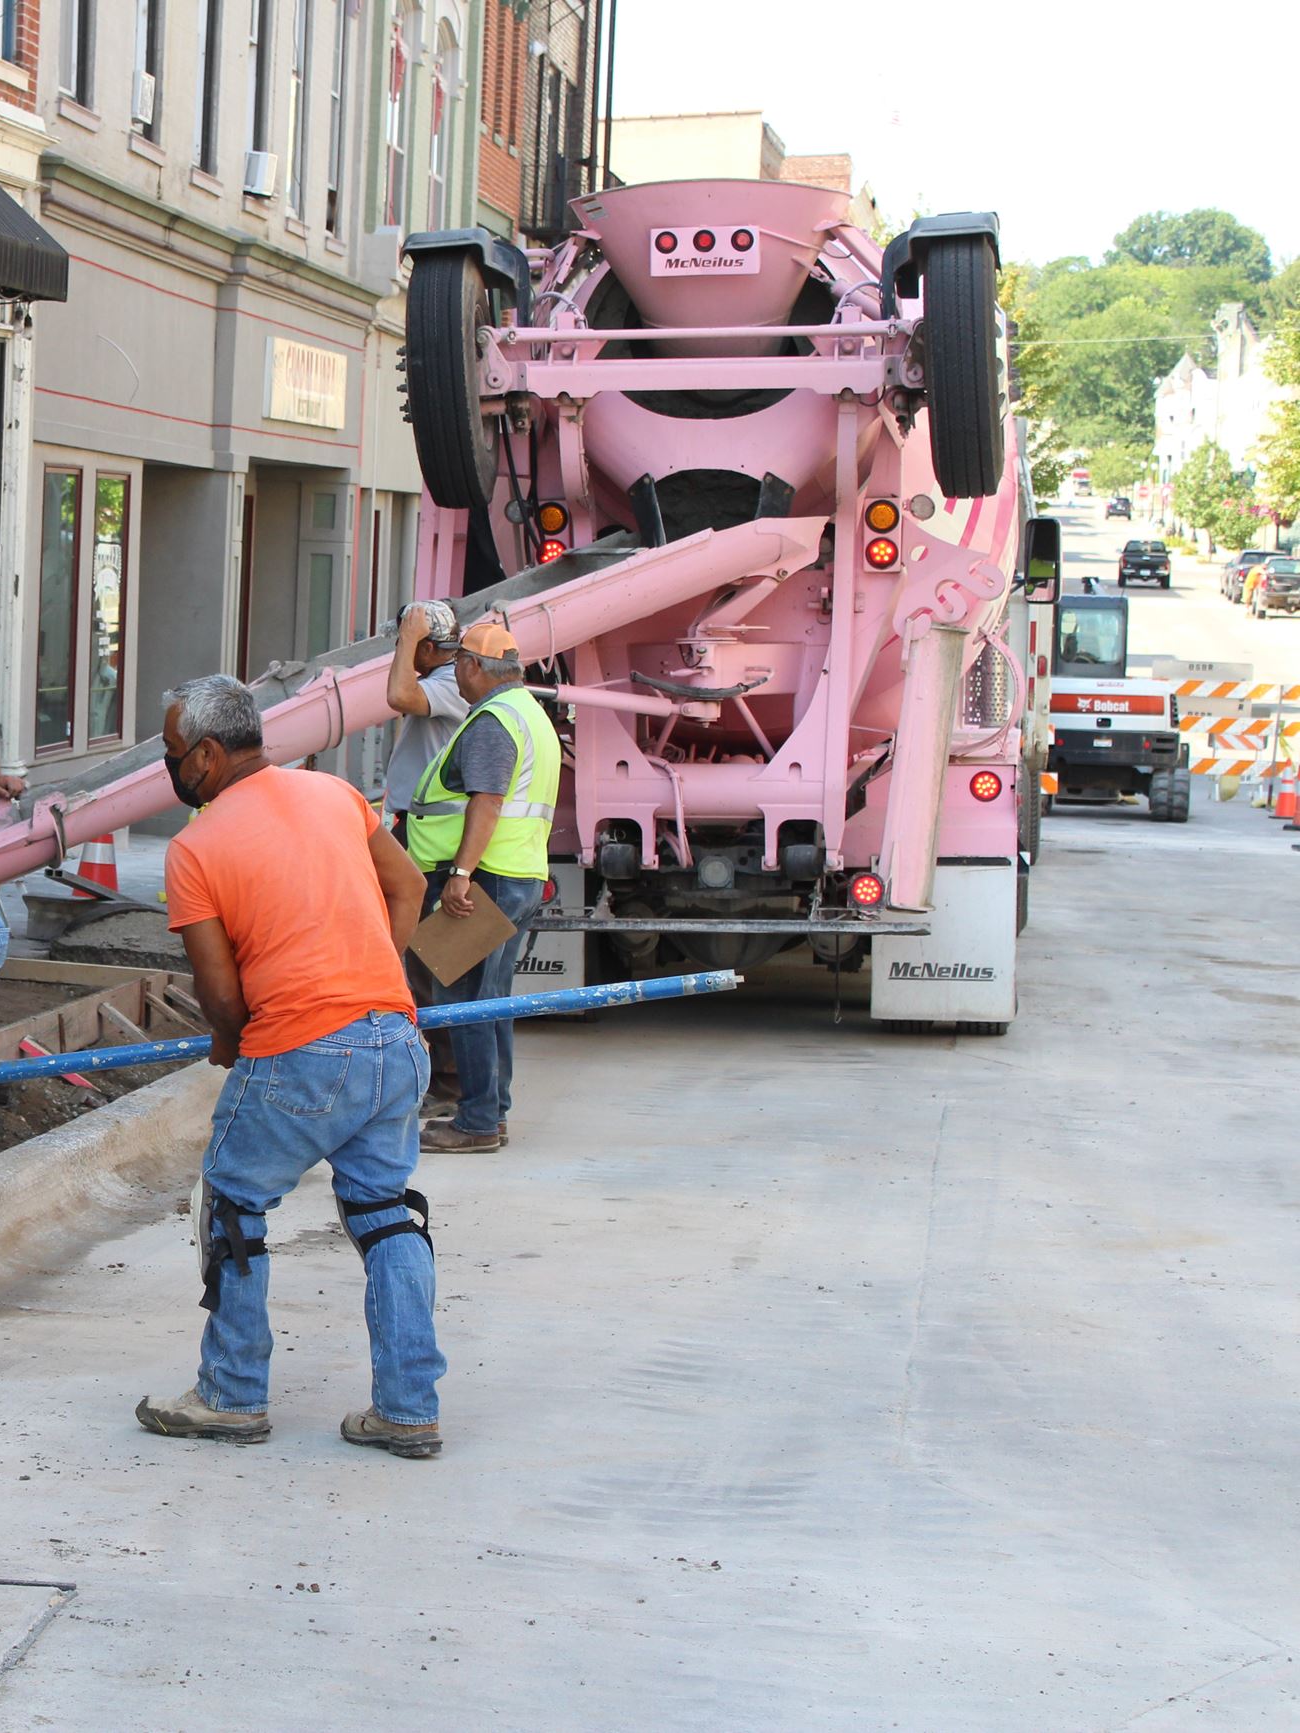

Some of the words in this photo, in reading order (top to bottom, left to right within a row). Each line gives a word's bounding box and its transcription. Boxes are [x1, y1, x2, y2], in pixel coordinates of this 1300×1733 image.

[665, 257, 745, 269] McNeilus
[1094, 699, 1129, 712] Bobcat
[889, 962, 995, 979] McNeilus
